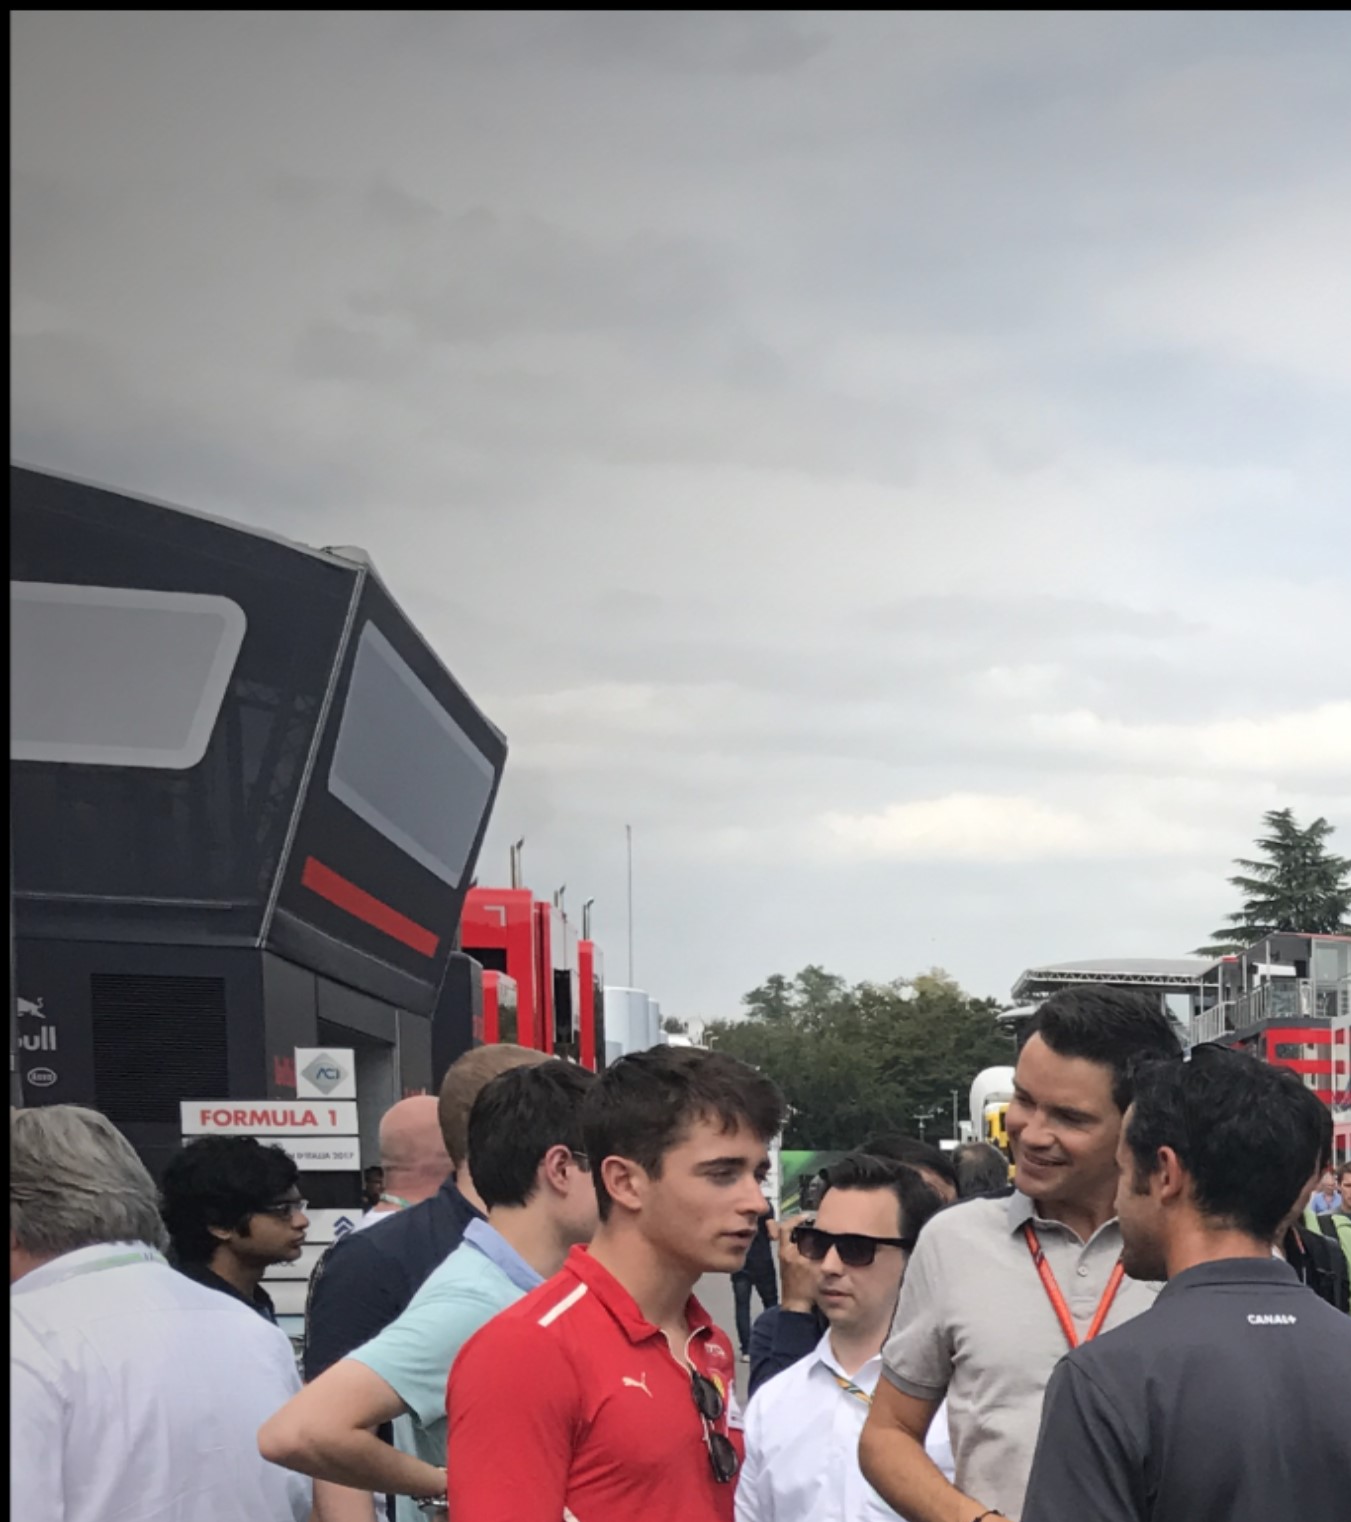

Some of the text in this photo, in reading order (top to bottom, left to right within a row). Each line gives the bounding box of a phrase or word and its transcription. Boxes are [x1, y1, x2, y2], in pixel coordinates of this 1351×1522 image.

[315, 1067, 341, 1080] ACI
[200, 1109, 338, 1127] FORMULA 1
